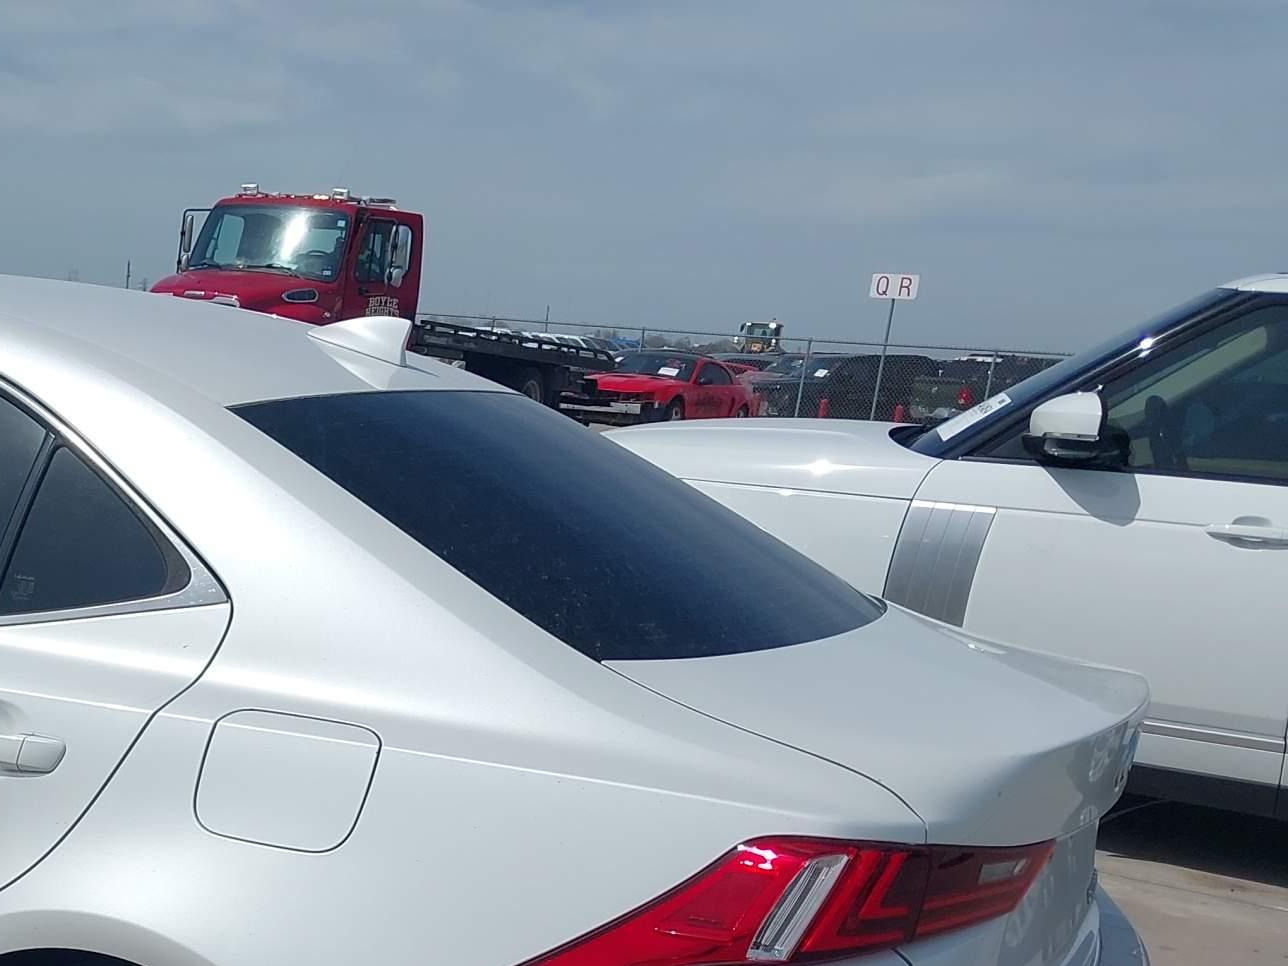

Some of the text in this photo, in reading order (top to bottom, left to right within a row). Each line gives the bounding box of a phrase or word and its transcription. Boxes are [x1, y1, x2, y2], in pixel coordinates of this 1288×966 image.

[876, 275, 913, 297] Q R
[368, 296, 399, 308] BOYLE
